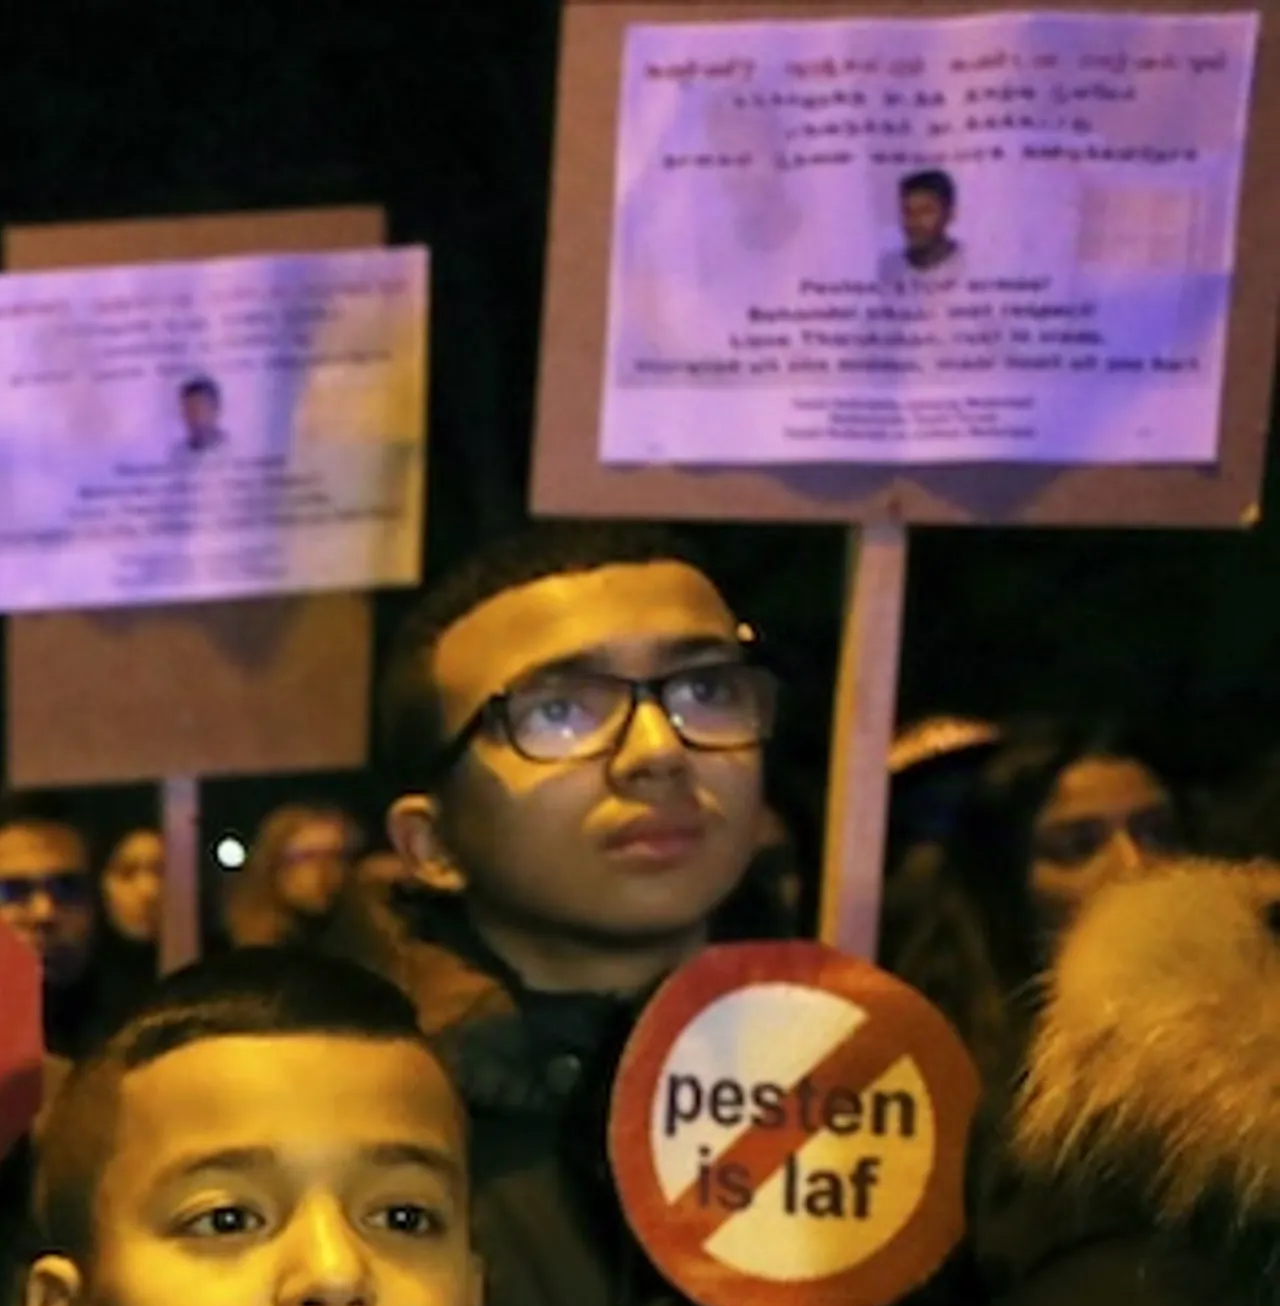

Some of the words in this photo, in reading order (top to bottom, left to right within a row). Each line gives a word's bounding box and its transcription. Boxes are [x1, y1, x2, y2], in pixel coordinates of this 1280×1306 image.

[664, 1072, 917, 1138] pesten
[696, 1146, 753, 1211] is
[782, 1152, 881, 1220] laf
